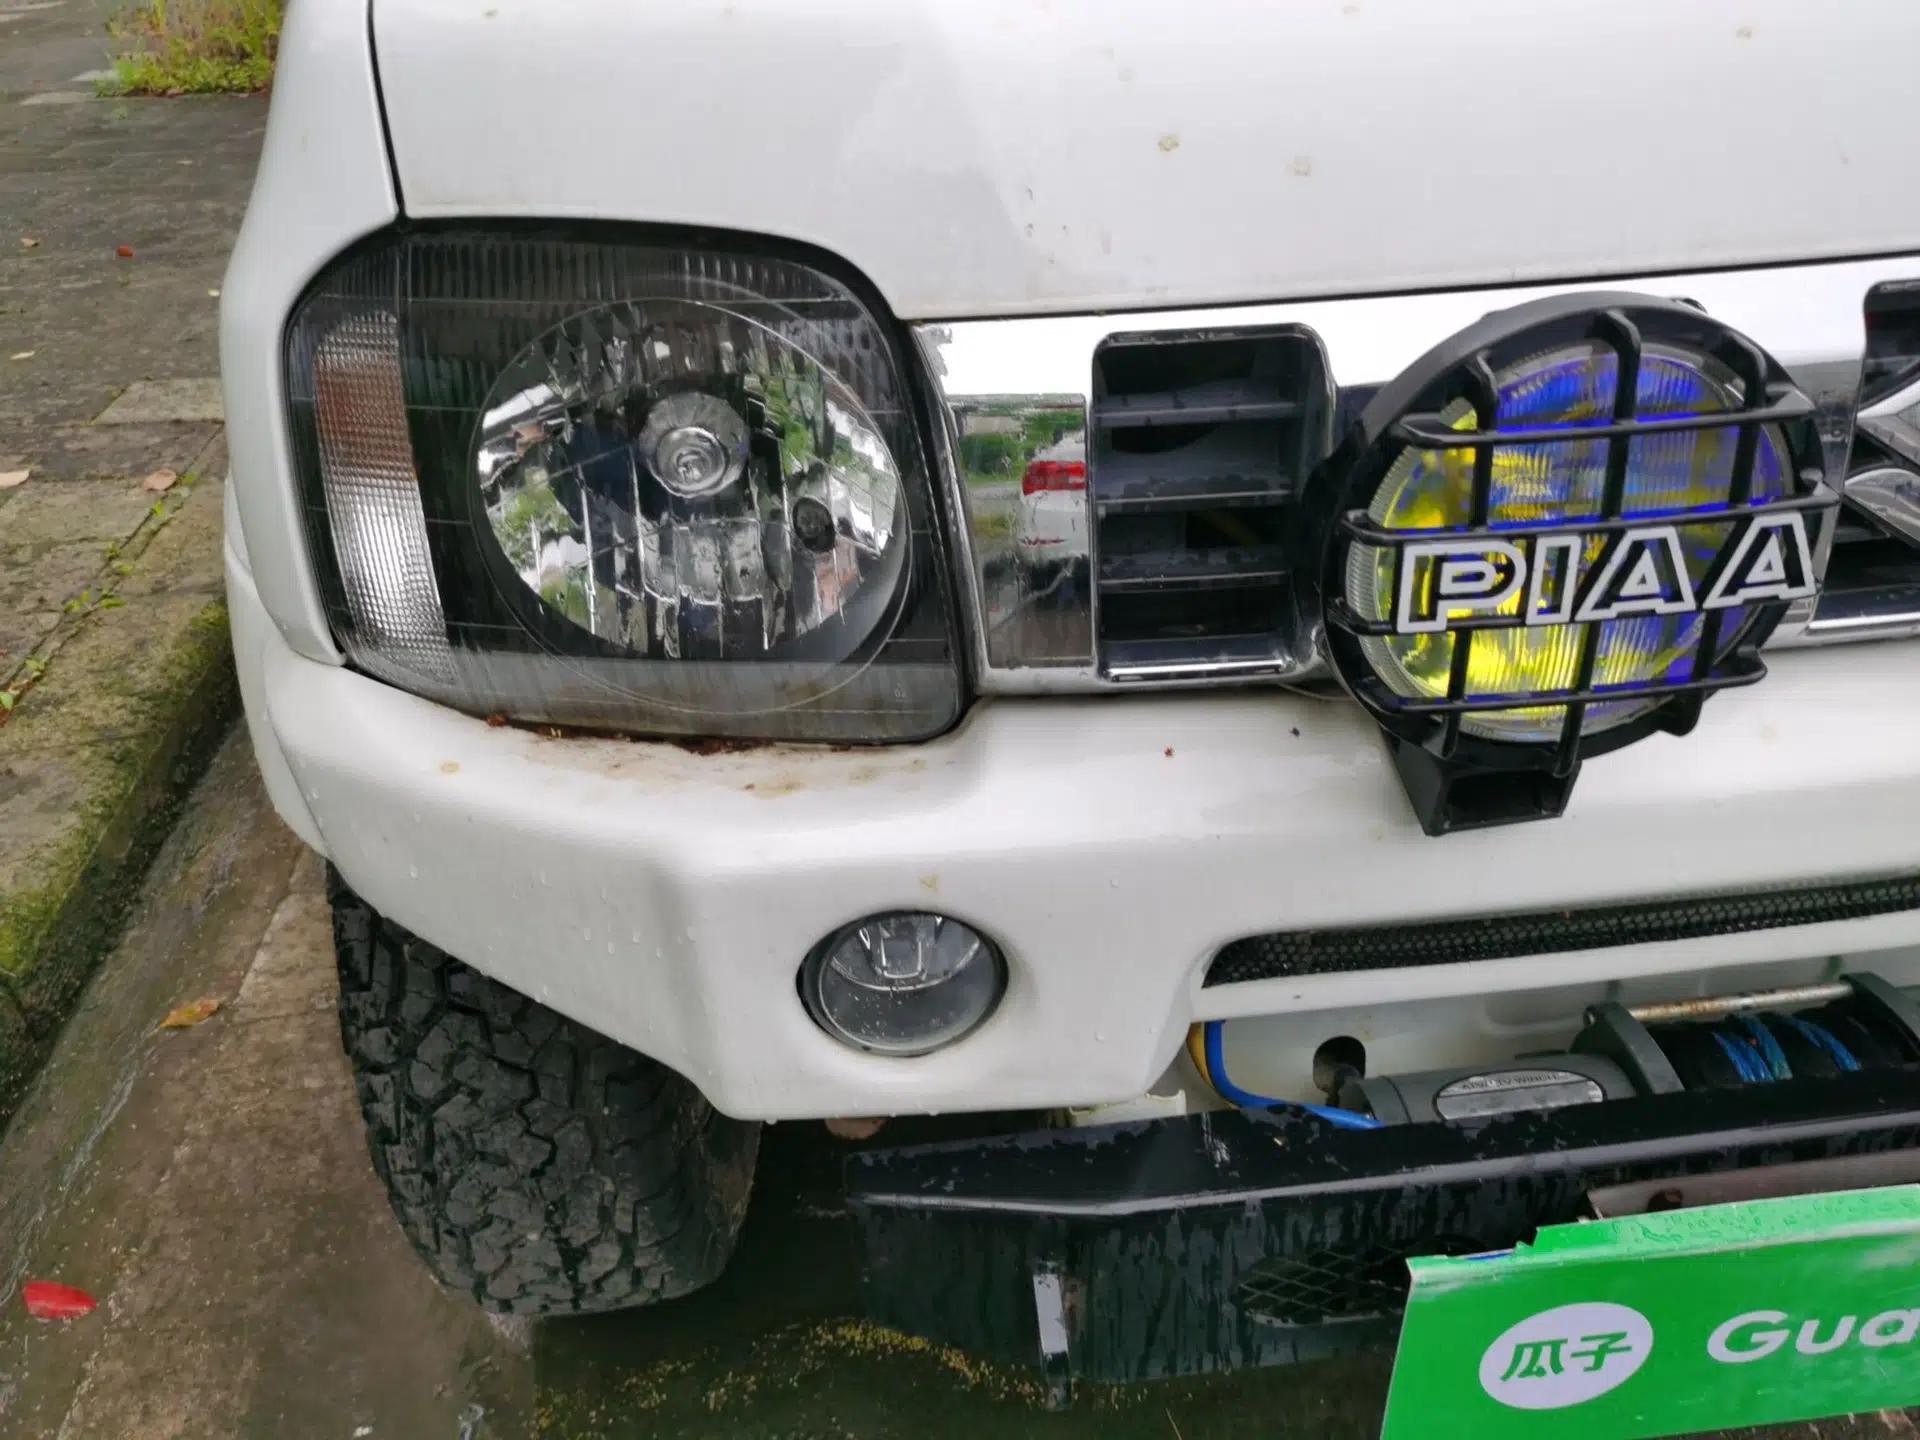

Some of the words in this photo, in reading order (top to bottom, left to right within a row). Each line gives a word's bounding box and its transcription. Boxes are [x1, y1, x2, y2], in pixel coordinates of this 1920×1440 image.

[1397, 512, 1817, 633] PIAA
[1500, 1331, 1633, 1383] 瓜子
[1706, 1308, 1920, 1364] Gua
